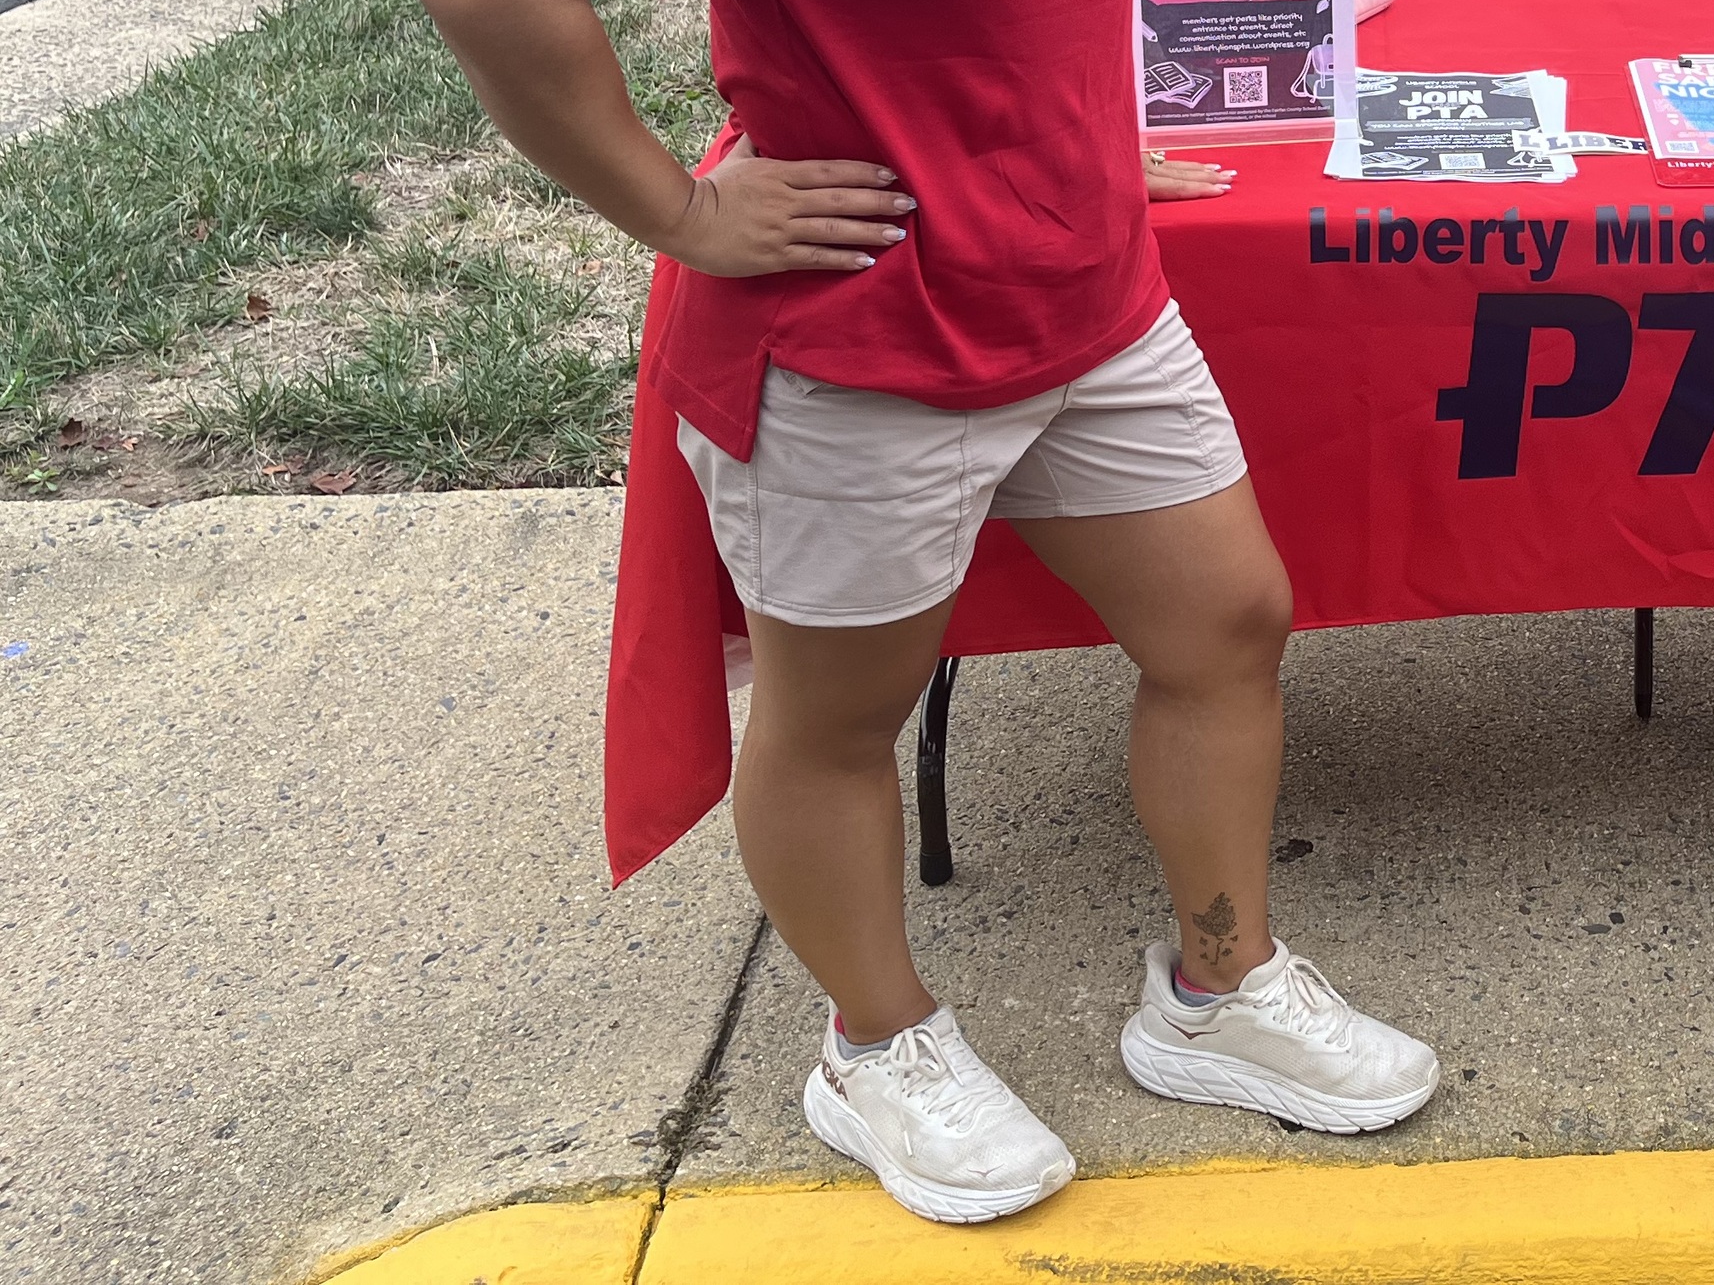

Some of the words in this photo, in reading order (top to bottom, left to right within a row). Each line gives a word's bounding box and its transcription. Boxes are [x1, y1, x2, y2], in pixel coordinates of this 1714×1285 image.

[1182, 17, 1218, 25] members
[1219, 16, 1235, 26] get
[1235, 15, 1257, 25] perks
[1273, 13, 1303, 24] priority
[1228, 24, 1238, 32] to
[1270, 21, 1294, 30] direct
[1179, 33, 1237, 43] communication
[1238, 32, 1262, 41] about
[1215, 57, 1237, 65] SCAN
[1399, 90, 1484, 106] JOIN
[1407, 104, 1488, 120] PTA
[1309, 206, 1569, 282] Liberty
[822, 1057, 849, 1101] OKA
